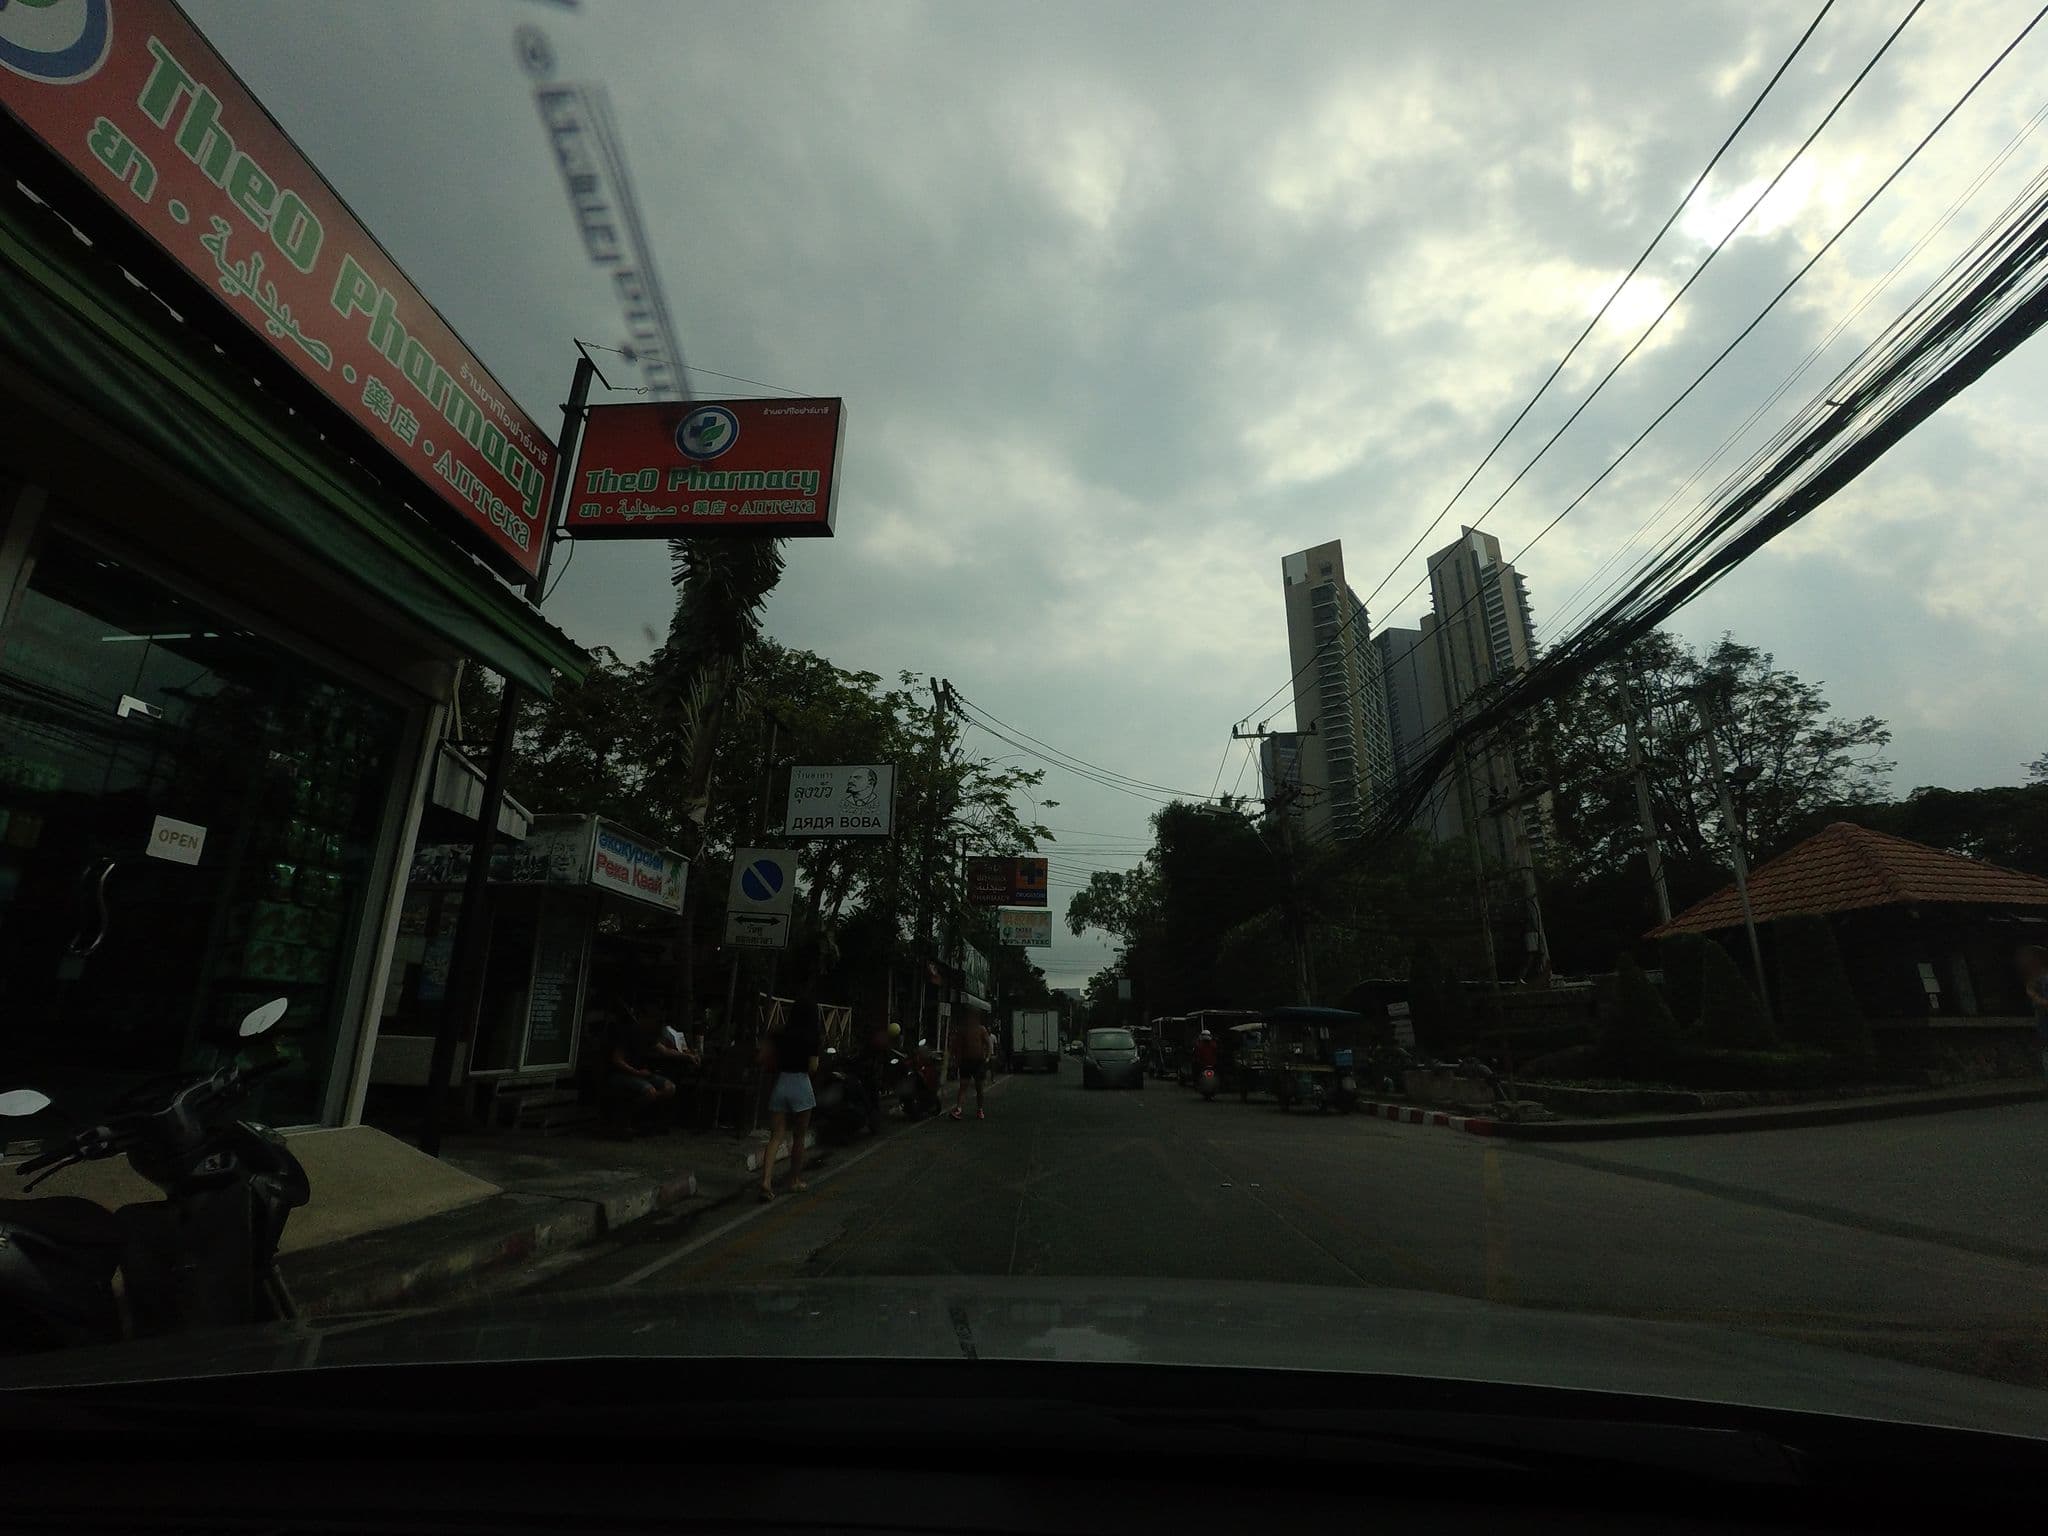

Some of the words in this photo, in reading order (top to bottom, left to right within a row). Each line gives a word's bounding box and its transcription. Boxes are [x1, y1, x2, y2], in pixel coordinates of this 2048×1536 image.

[86, 116, 159, 203] ยา
[200, 215, 333, 372] صيدلية
[137, 35, 325, 274] TheO
[331, 252, 546, 518] Pharmacy
[586, 468, 660, 494] TheO
[668, 466, 820, 495] Pharmacy
[579, 502, 601, 518] ยา
[616, 497, 678, 521] صيدلية
[792, 817, 834, 831] ДЯДЯ
[840, 817, 882, 828] ВОВА
[158, 829, 199, 850] OPEN
